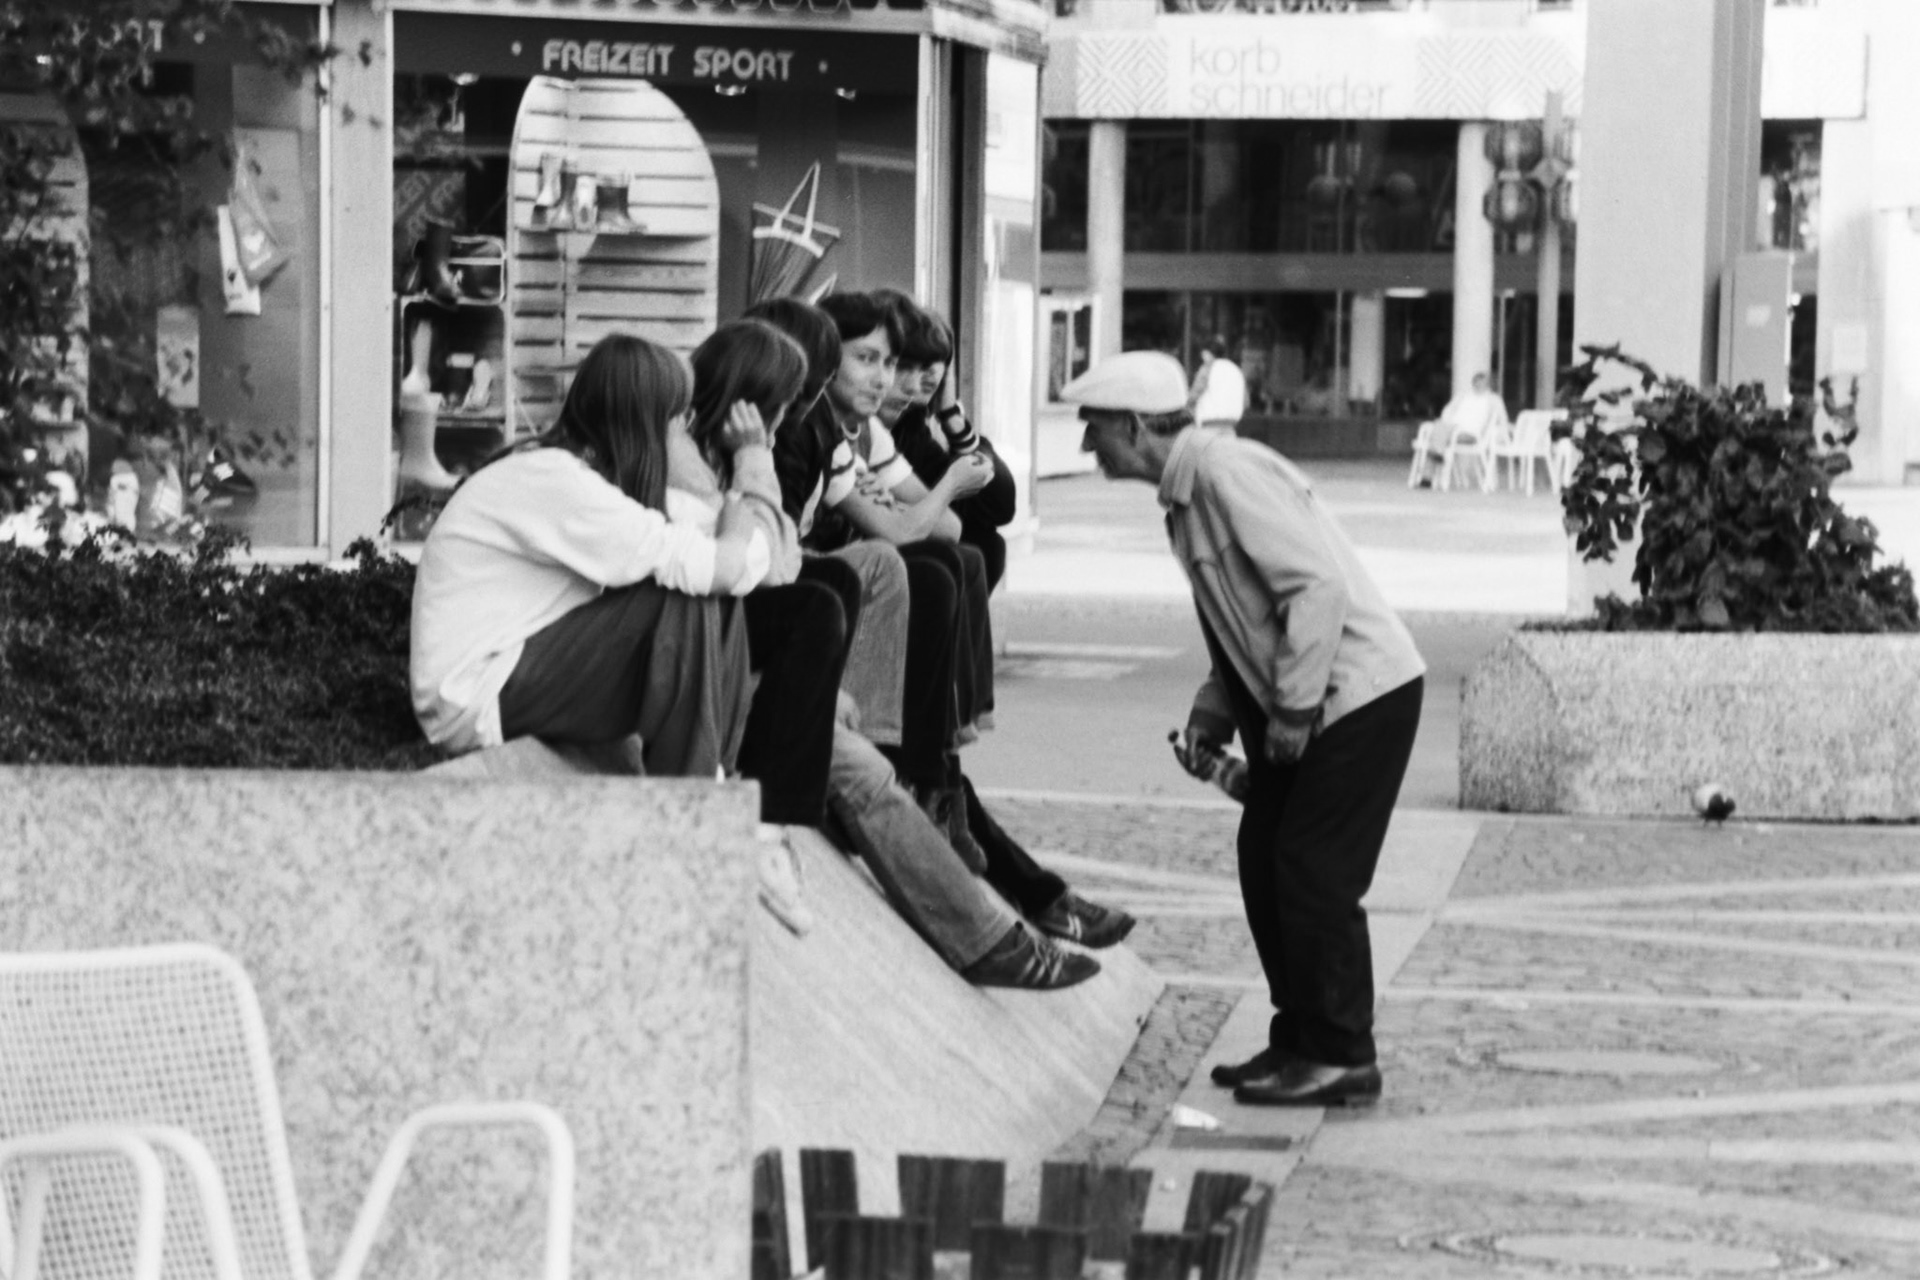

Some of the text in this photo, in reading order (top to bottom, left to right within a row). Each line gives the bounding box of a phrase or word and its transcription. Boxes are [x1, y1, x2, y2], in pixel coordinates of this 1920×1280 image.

[543, 39, 794, 80] FREIZEIT SPORT
[1189, 36, 1281, 76] korb
[1189, 73, 1392, 115] schneider
